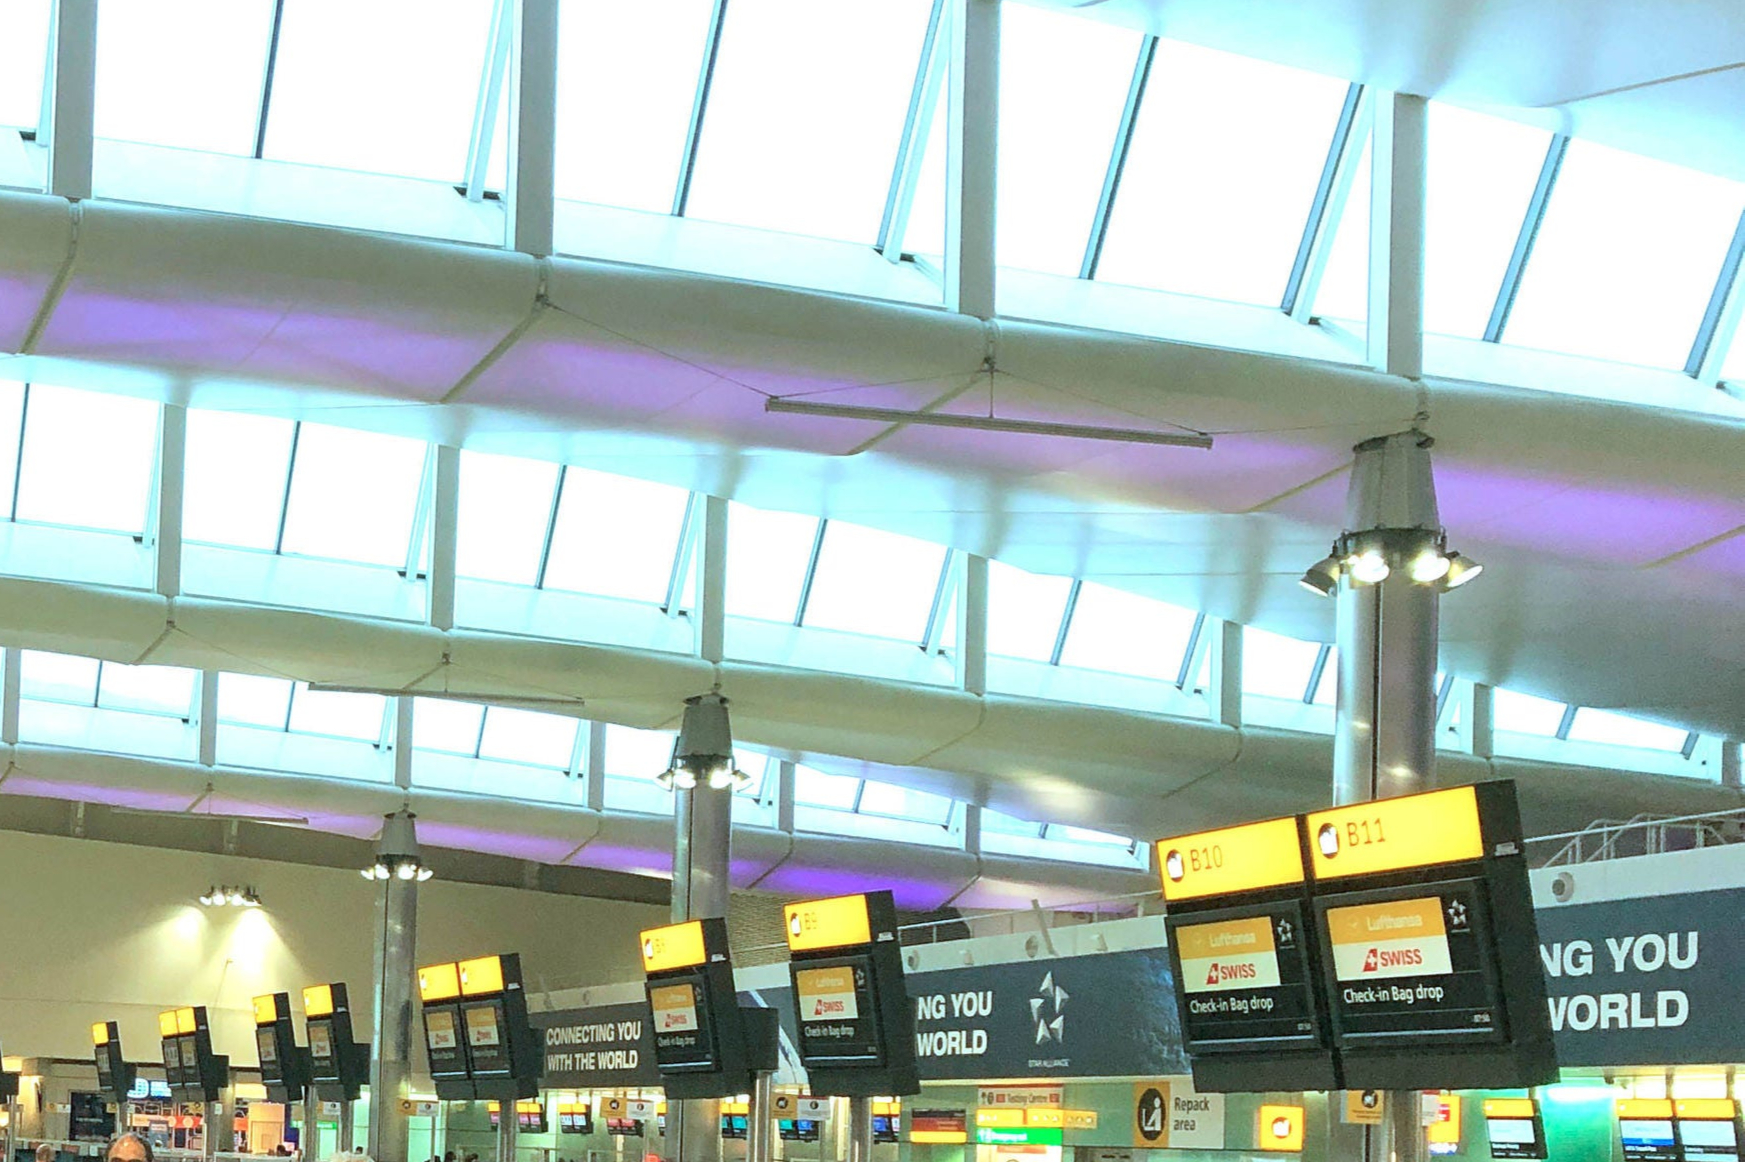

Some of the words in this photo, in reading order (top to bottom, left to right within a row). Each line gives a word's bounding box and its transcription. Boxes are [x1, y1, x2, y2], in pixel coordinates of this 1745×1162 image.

[1346, 817, 1387, 848] B11
[1189, 844, 1224, 872] B10
[1366, 914, 1423, 931] Lufthansa
[1380, 948, 1423, 967] SWISS
[1539, 939, 1594, 977] NG
[1605, 931, 1699, 973] YOU
[1221, 963, 1256, 980] SWISS
[1343, 986, 1390, 1004] Check-in
[1391, 985, 1415, 1004] Bag
[1415, 983, 1444, 1002] drop
[823, 1000, 845, 1013] SWISS
[918, 994, 946, 1020] NG
[950, 990, 993, 1018] YOU
[1189, 997, 1229, 1014] Check-in
[1229, 996, 1250, 1014] Bag
[1250, 995, 1274, 1013] drop
[546, 1023, 615, 1046] CONNECTING
[617, 1020, 642, 1041] YOU
[917, 1029, 988, 1057] WORLD
[547, 1054, 573, 1072] WITH
[574, 1052, 596, 1070] THE
[597, 1050, 638, 1070] WORLD
[1174, 1096, 1210, 1114] Repack
[1173, 1119, 1196, 1131] area
